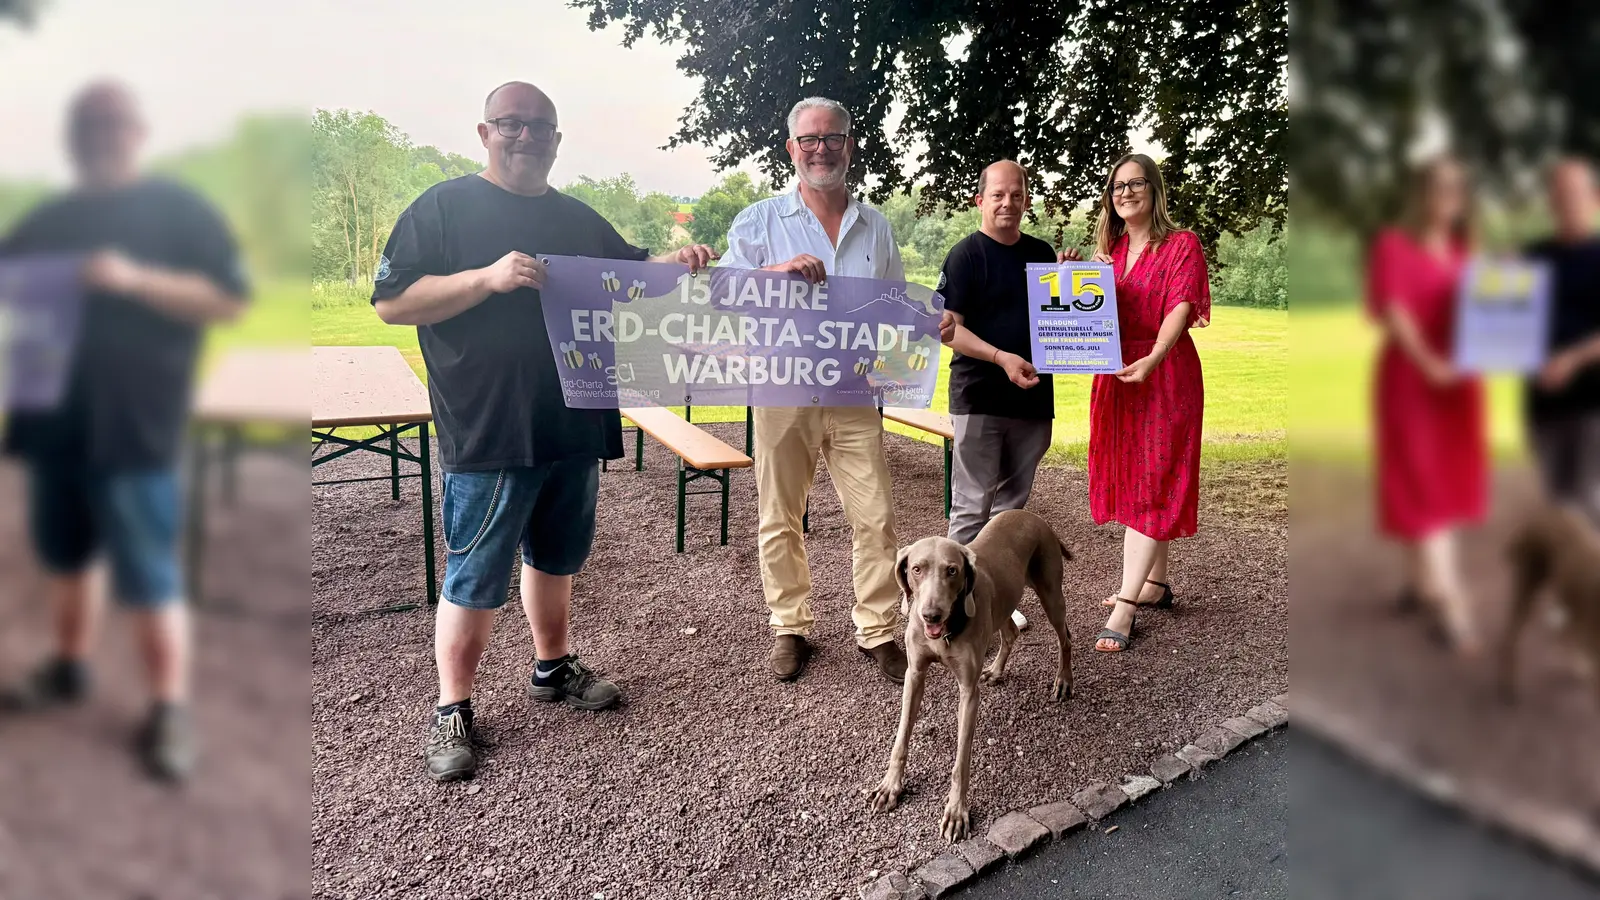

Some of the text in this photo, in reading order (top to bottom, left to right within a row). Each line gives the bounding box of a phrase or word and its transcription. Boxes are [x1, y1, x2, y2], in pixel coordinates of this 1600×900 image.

[676, 272, 829, 311] 15 JAHRE
[1039, 269, 1105, 312] 15
[571, 309, 916, 352] ERD-CHARTA-STADT
[662, 353, 842, 387] WARBURG
